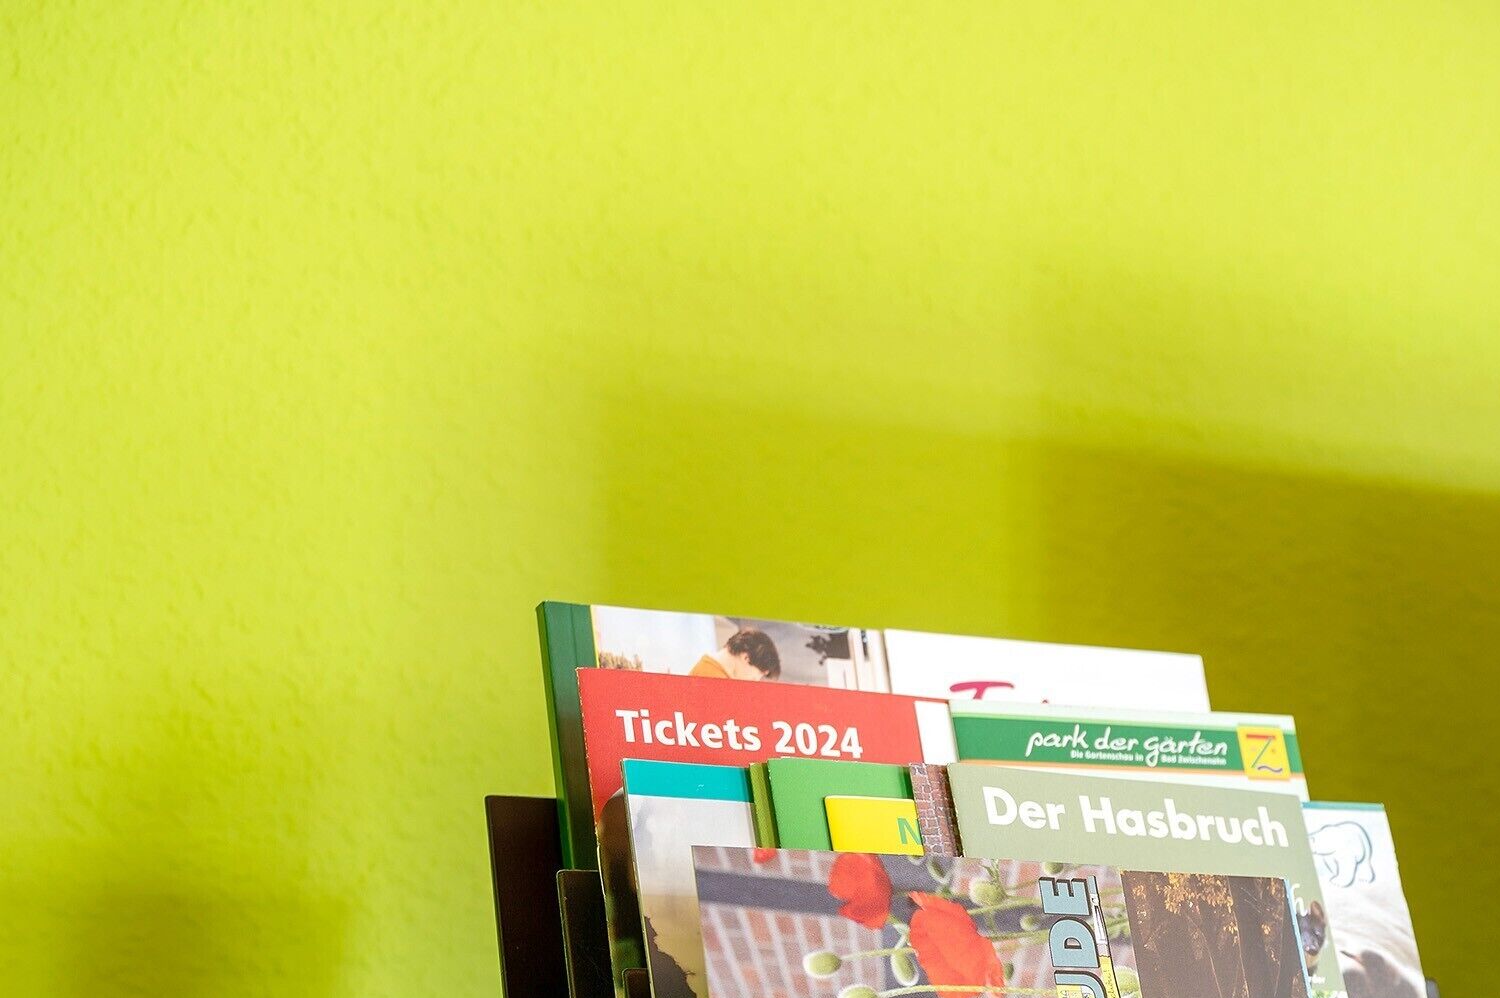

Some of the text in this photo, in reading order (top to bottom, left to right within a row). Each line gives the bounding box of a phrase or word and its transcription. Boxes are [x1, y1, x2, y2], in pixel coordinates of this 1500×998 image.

[615, 708, 864, 758] Tickets 2024
[1025, 723, 1228, 767] park der gärten
[982, 786, 1289, 847] Der Hasbruch
